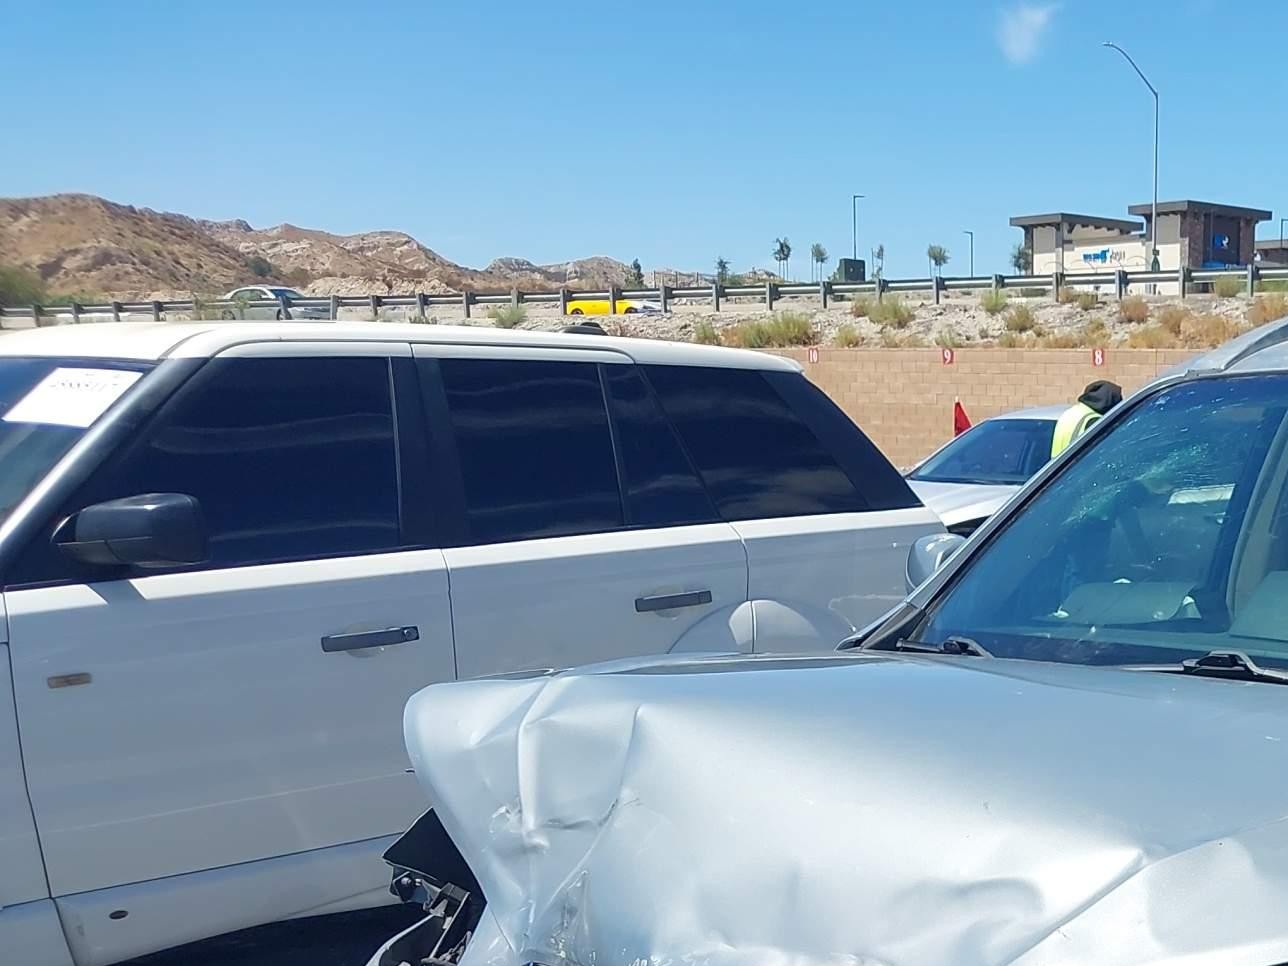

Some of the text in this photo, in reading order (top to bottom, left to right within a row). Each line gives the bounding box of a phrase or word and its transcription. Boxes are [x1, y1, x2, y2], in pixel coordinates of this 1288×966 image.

[809, 349, 818, 363] 10
[943, 349, 952, 365] 9
[1094, 349, 1103, 366] 8
